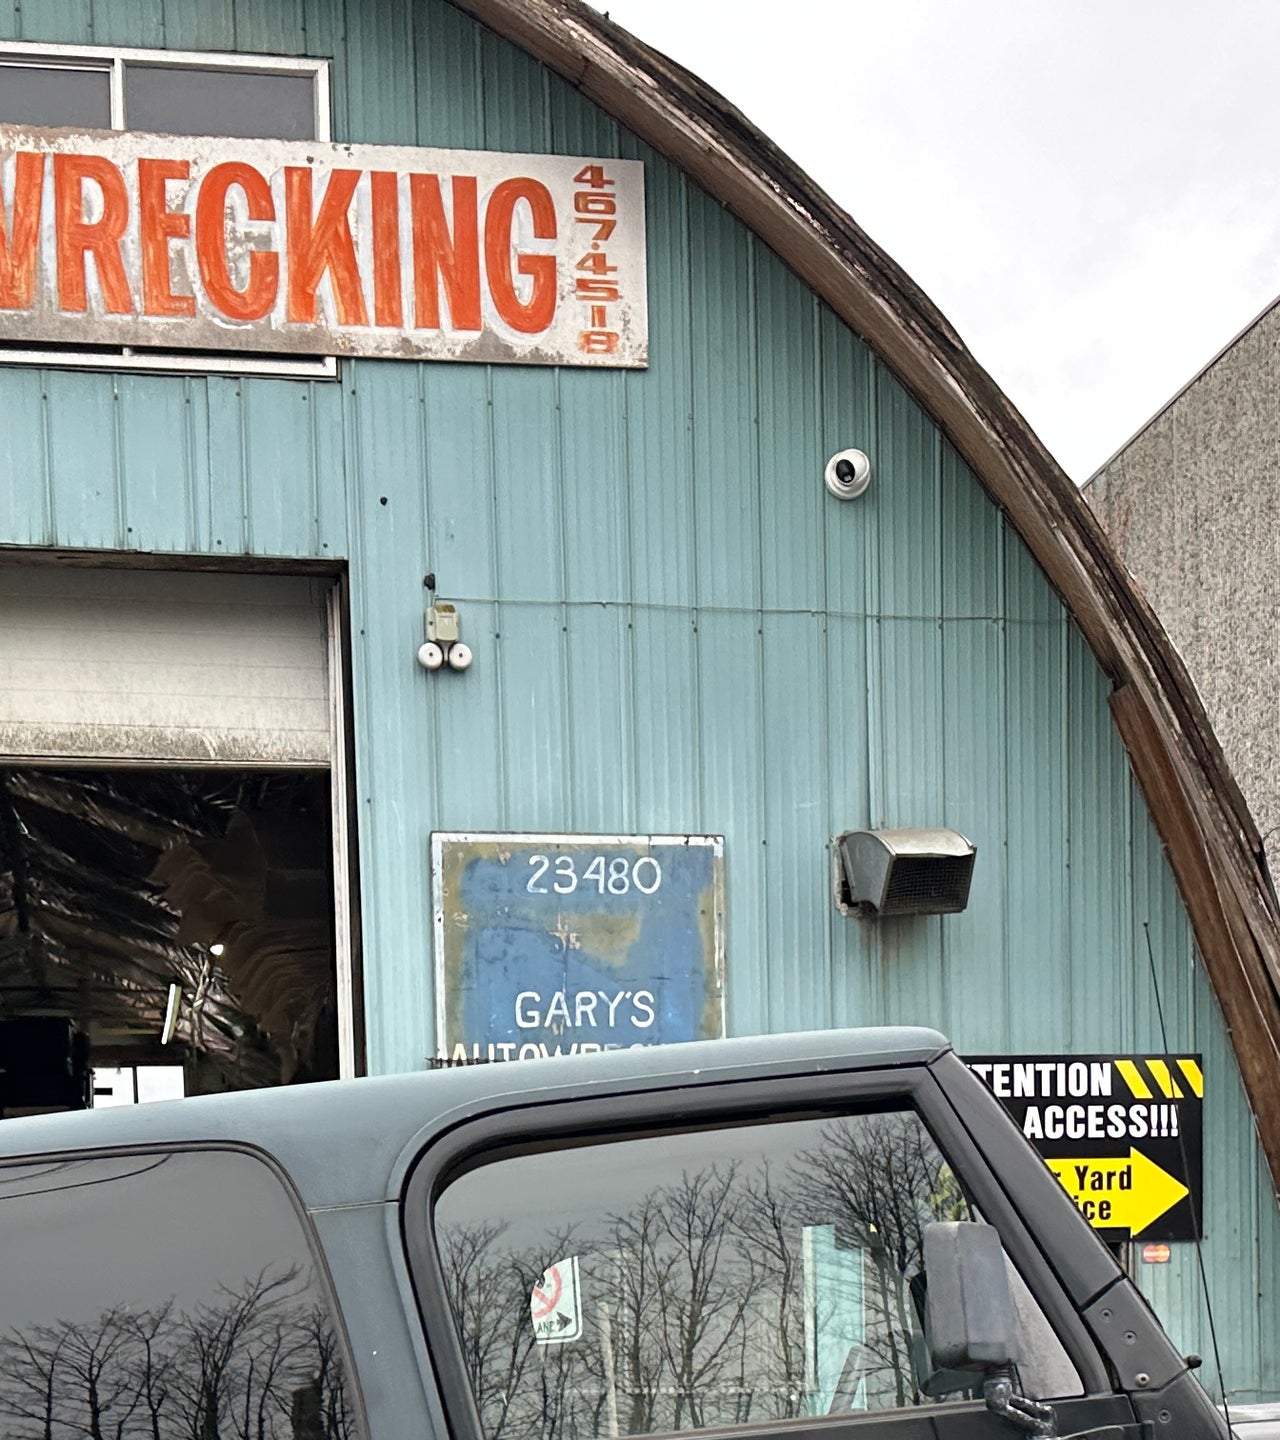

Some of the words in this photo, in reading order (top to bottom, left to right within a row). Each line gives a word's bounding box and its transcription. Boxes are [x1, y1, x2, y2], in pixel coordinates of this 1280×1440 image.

[526, 855, 662, 895] 23480
[515, 990, 655, 1028] GARY'S
[966, 1063, 1112, 1098] TENTION
[1023, 1104, 1179, 1139] ACCESS!!!
[1074, 1164, 1132, 1191] Yard
[536, 1320, 554, 1334] ANE
